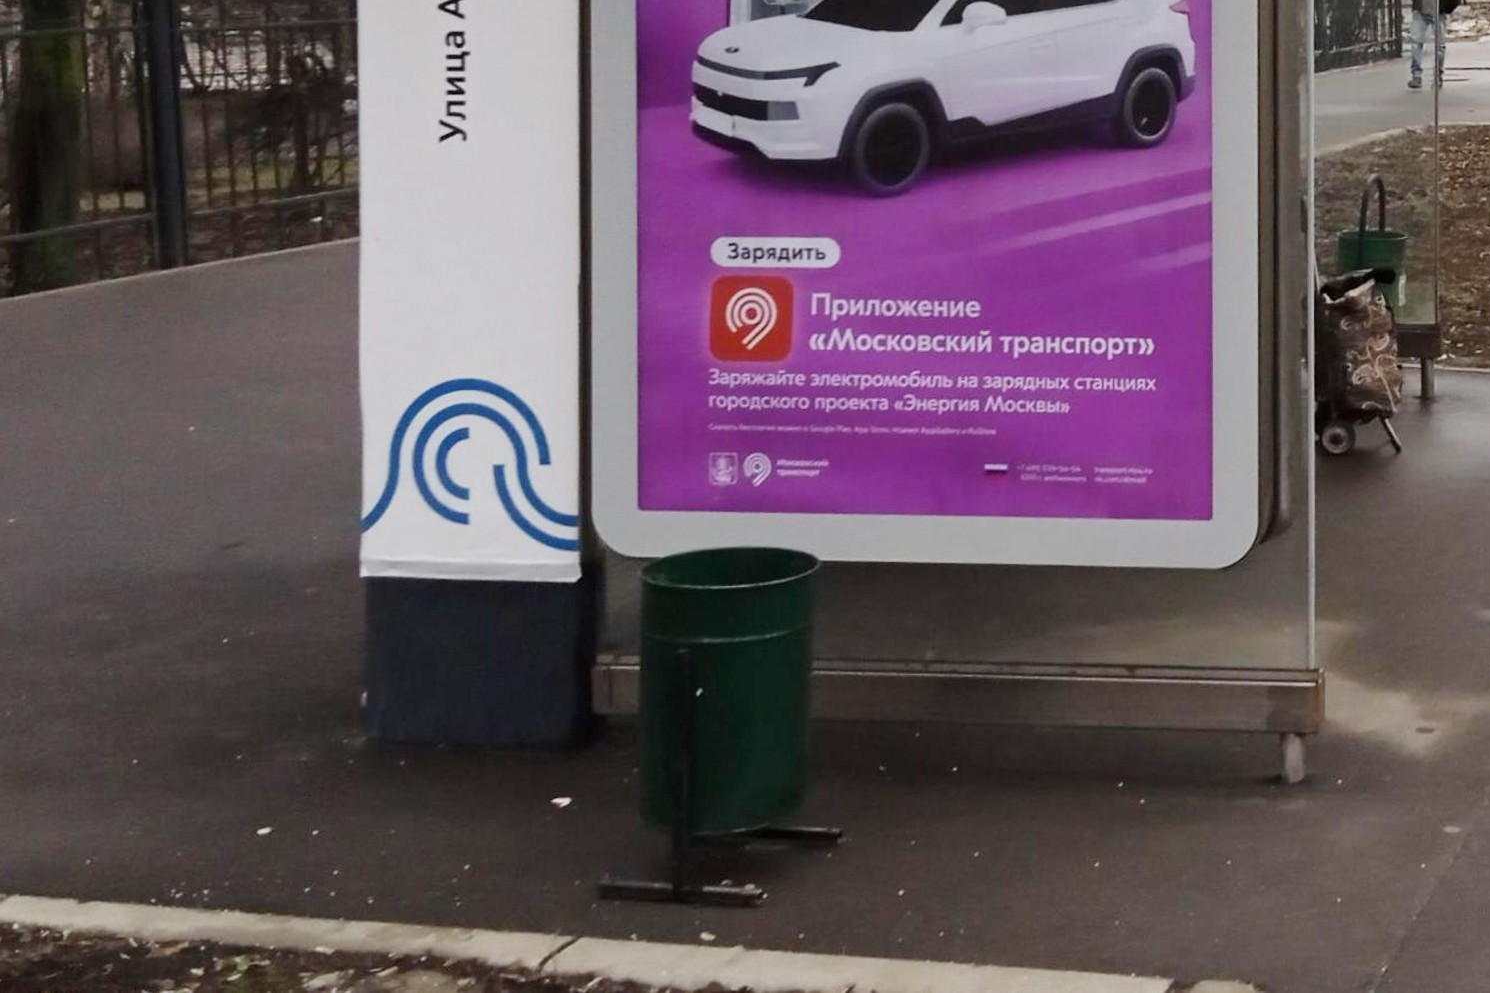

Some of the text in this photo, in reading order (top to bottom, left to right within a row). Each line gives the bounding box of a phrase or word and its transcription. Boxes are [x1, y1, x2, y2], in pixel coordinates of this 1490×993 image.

[438, 31, 471, 143] Улица
[727, 242, 827, 264] Зарядить
[811, 293, 981, 320] Приложение
[809, 328, 1156, 359] «Московский транспорт»
[708, 368, 1156, 392] Заряжайте электромобиль на зарядных станциях
[708, 394, 1071, 415] городского проекта «Энергия Москвы»
